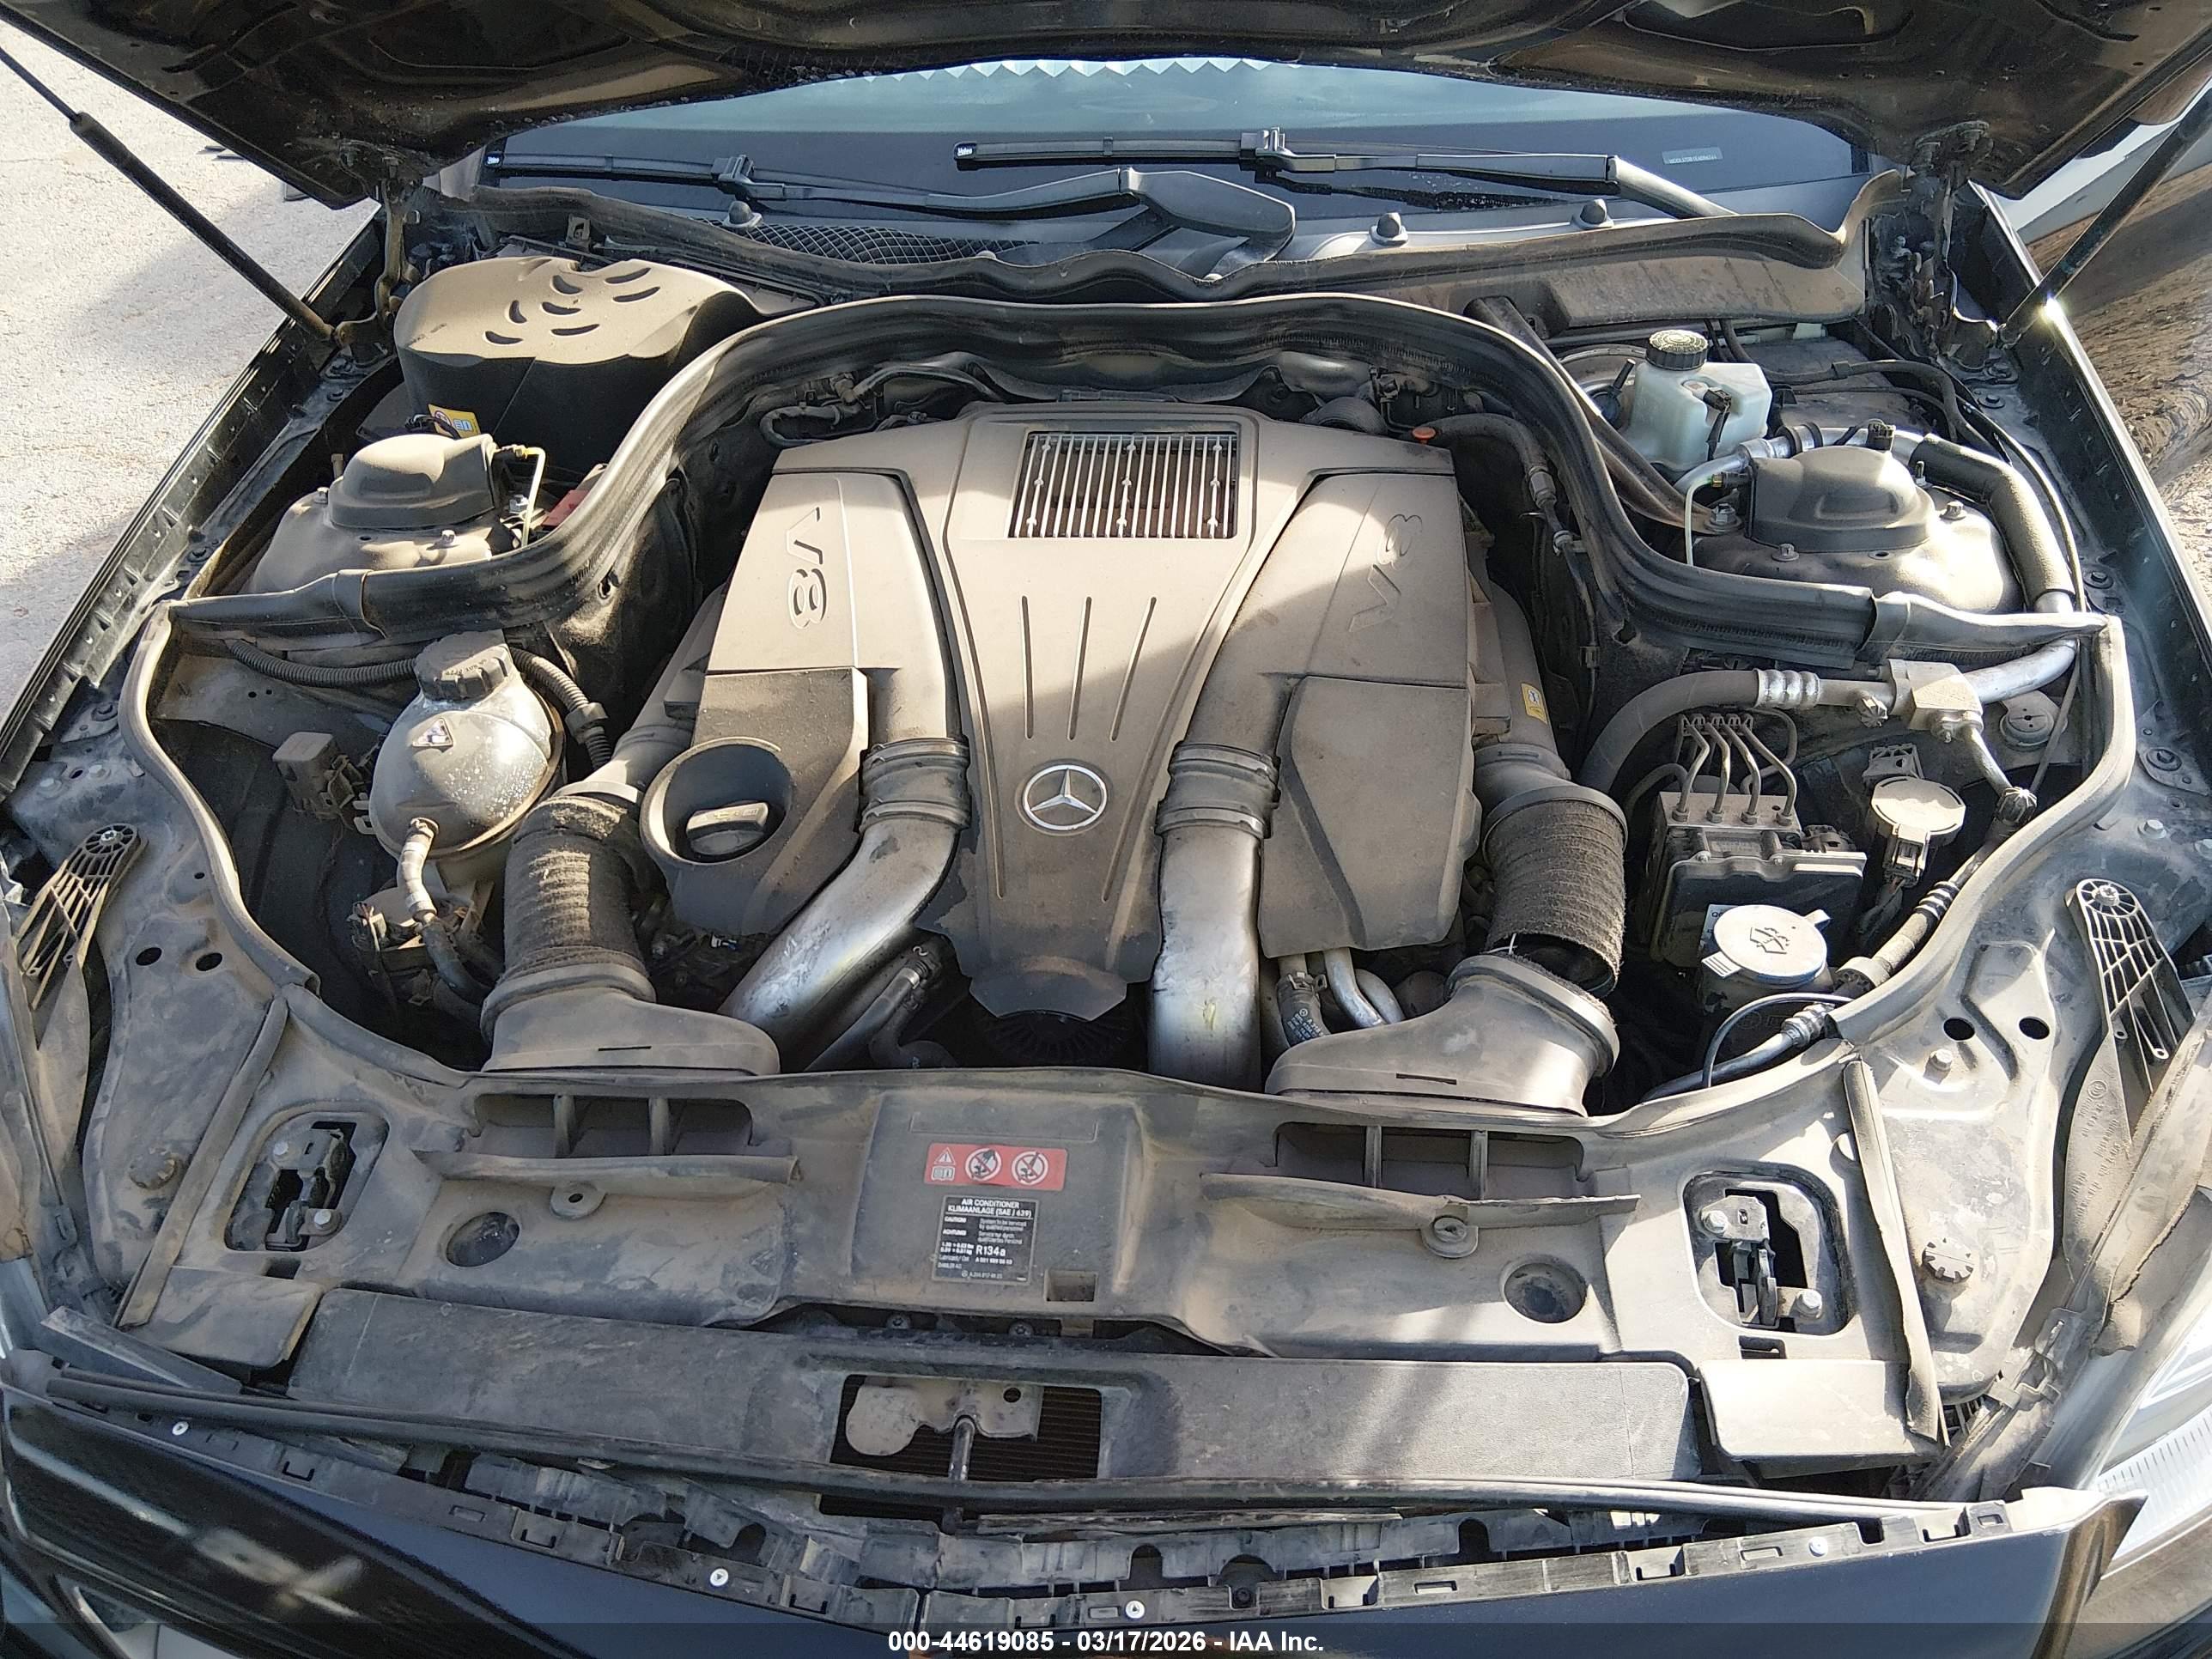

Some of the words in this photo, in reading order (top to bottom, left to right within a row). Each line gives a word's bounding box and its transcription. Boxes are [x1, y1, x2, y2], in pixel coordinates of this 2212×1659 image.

[786, 506, 827, 629] V8
[1347, 513, 1423, 633] V8
[975, 1200, 1020, 1209] CONDITIONER
[948, 1205, 995, 1214] KLIMAANLAGE
[1017, 1210, 1032, 1218] 639)
[976, 1245, 1006, 1256] R134a
